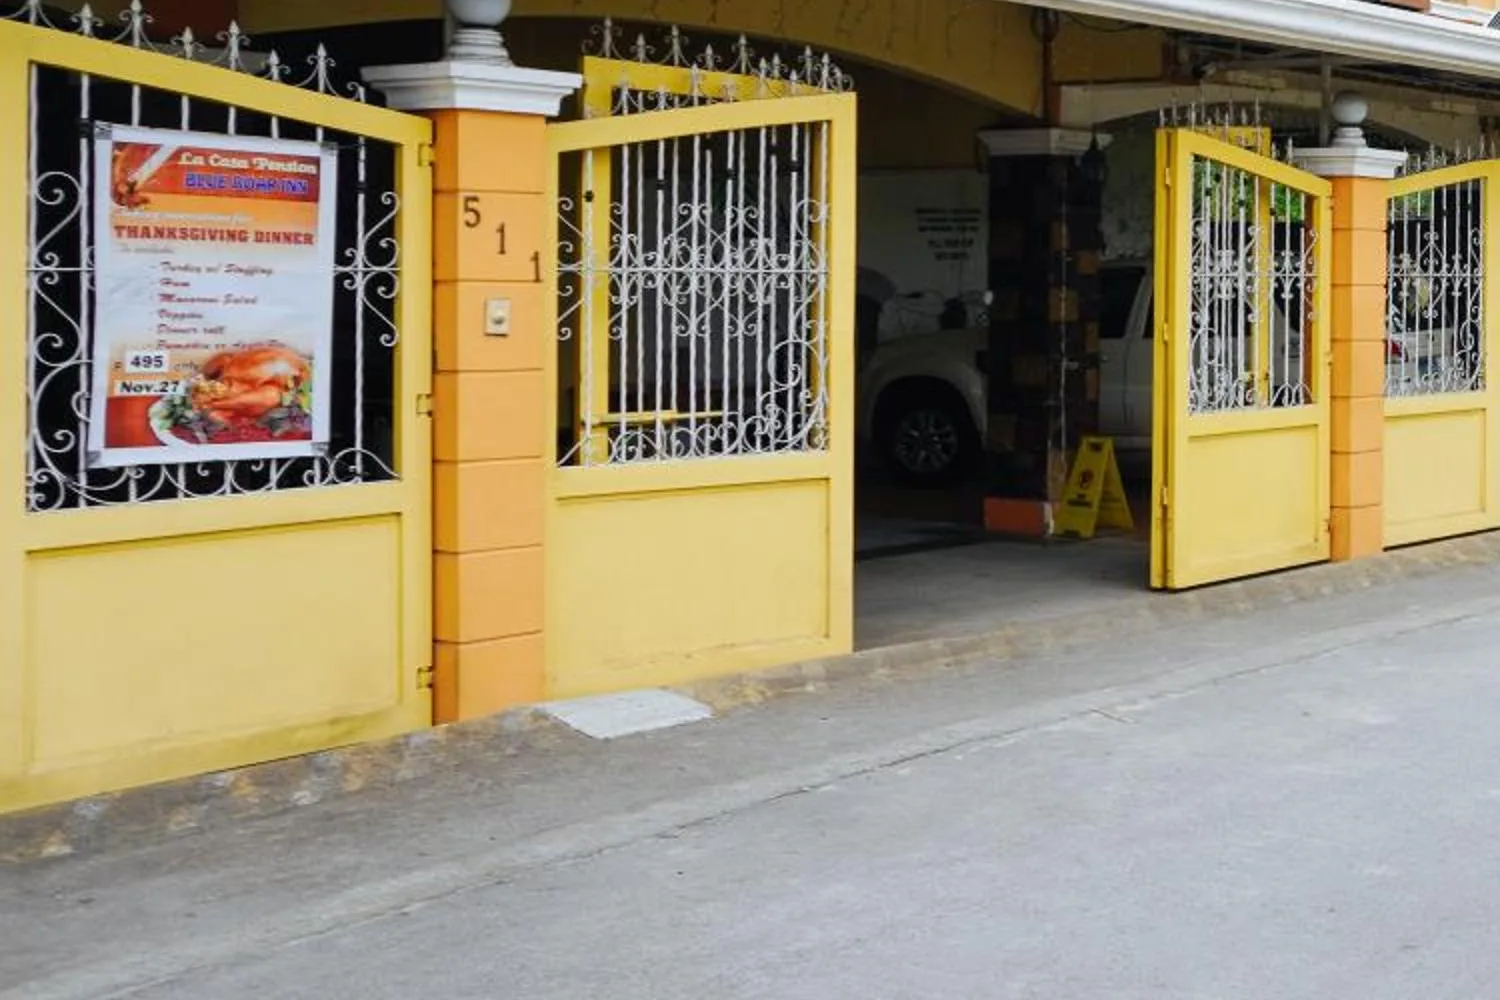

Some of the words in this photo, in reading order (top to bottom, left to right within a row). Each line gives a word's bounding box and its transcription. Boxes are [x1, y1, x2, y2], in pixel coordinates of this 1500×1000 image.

[178, 152, 205, 166] La
[184, 172, 225, 189] BLUE
[113, 225, 249, 243] THANKSGIVING
[253, 230, 315, 246] DINNER
[131, 355, 164, 368] 495
[119, 381, 180, 393] Nov.27
